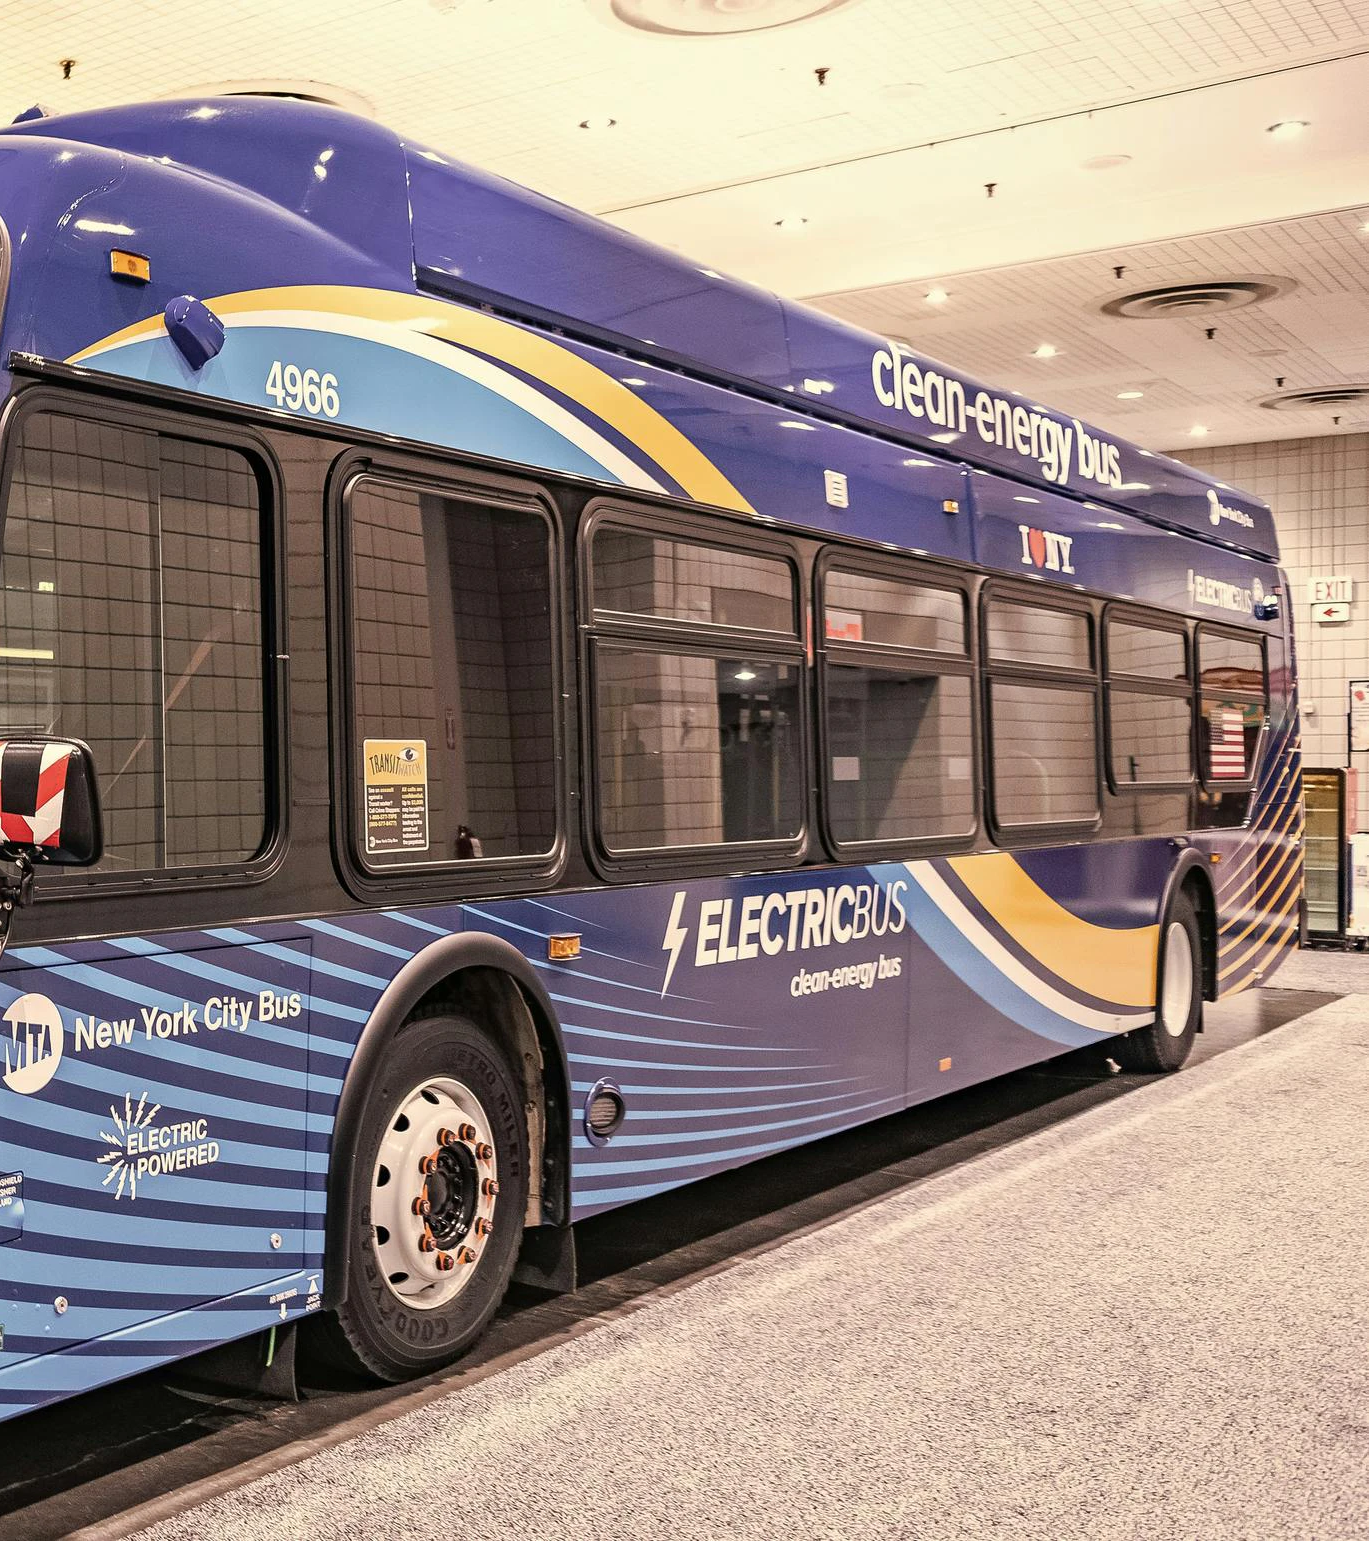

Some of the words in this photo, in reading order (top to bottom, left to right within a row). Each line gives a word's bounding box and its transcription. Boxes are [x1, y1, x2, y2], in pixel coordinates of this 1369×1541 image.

[265, 360, 340, 418] 4966
[872, 341, 1073, 485] clean-energy
[1071, 418, 1123, 488] bus
[1315, 581, 1348, 601] EXIT
[695, 880, 908, 967] ELECTRICBUS
[791, 960, 878, 997] clean-energy
[877, 954, 903, 979] bus
[75, 1015, 135, 1052] New
[140, 1001, 199, 1041] York
[203, 996, 253, 1033] City
[258, 990, 302, 1023] Bus
[127, 1118, 208, 1156] ELECTRIC
[136, 1142, 220, 1180] POWERED
